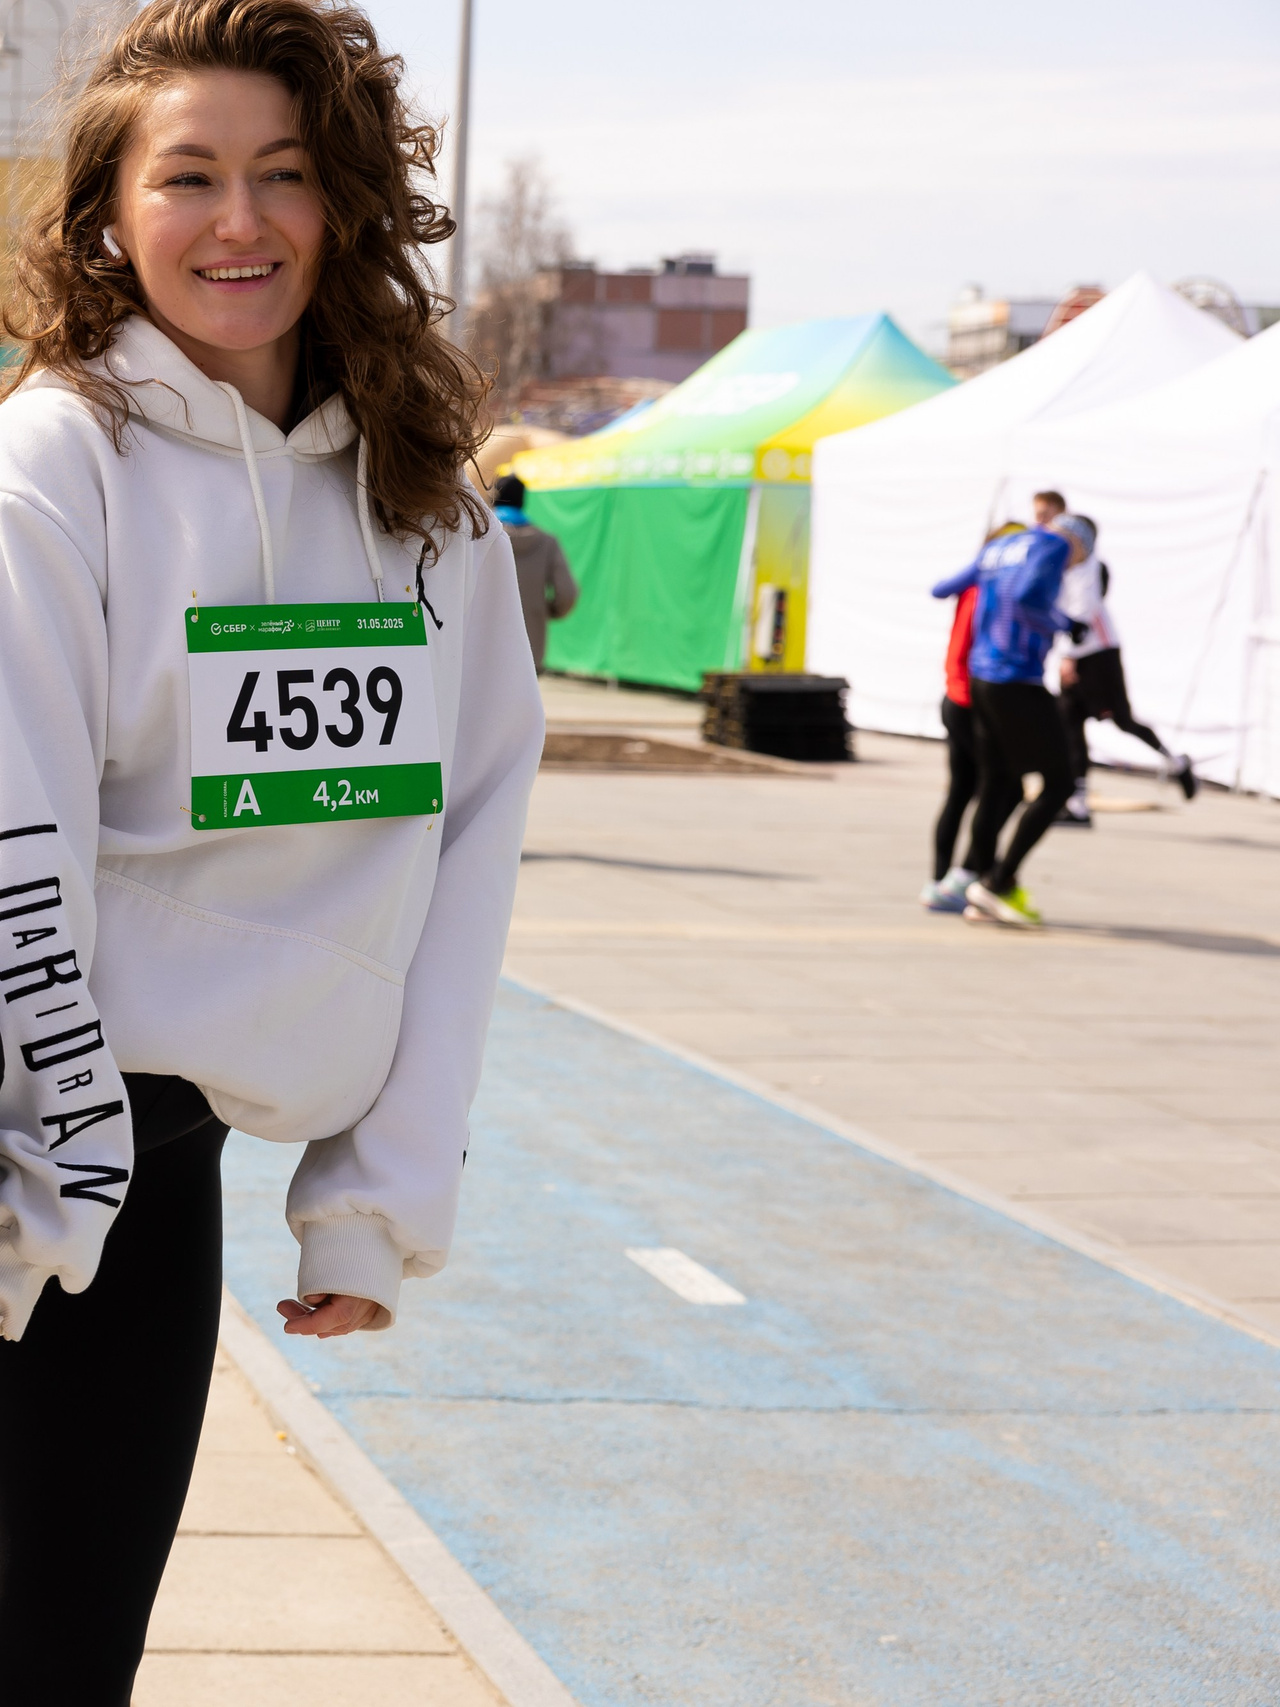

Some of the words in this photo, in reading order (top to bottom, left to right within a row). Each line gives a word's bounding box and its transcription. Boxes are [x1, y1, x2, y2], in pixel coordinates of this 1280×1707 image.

[223, 624, 247, 633] СБЕР
[316, 619, 341, 628] ЦЕНТР
[357, 618, 404, 629] 31.05.2025
[227, 666, 403, 752] 4539
[313, 780, 352, 811] 4,2
